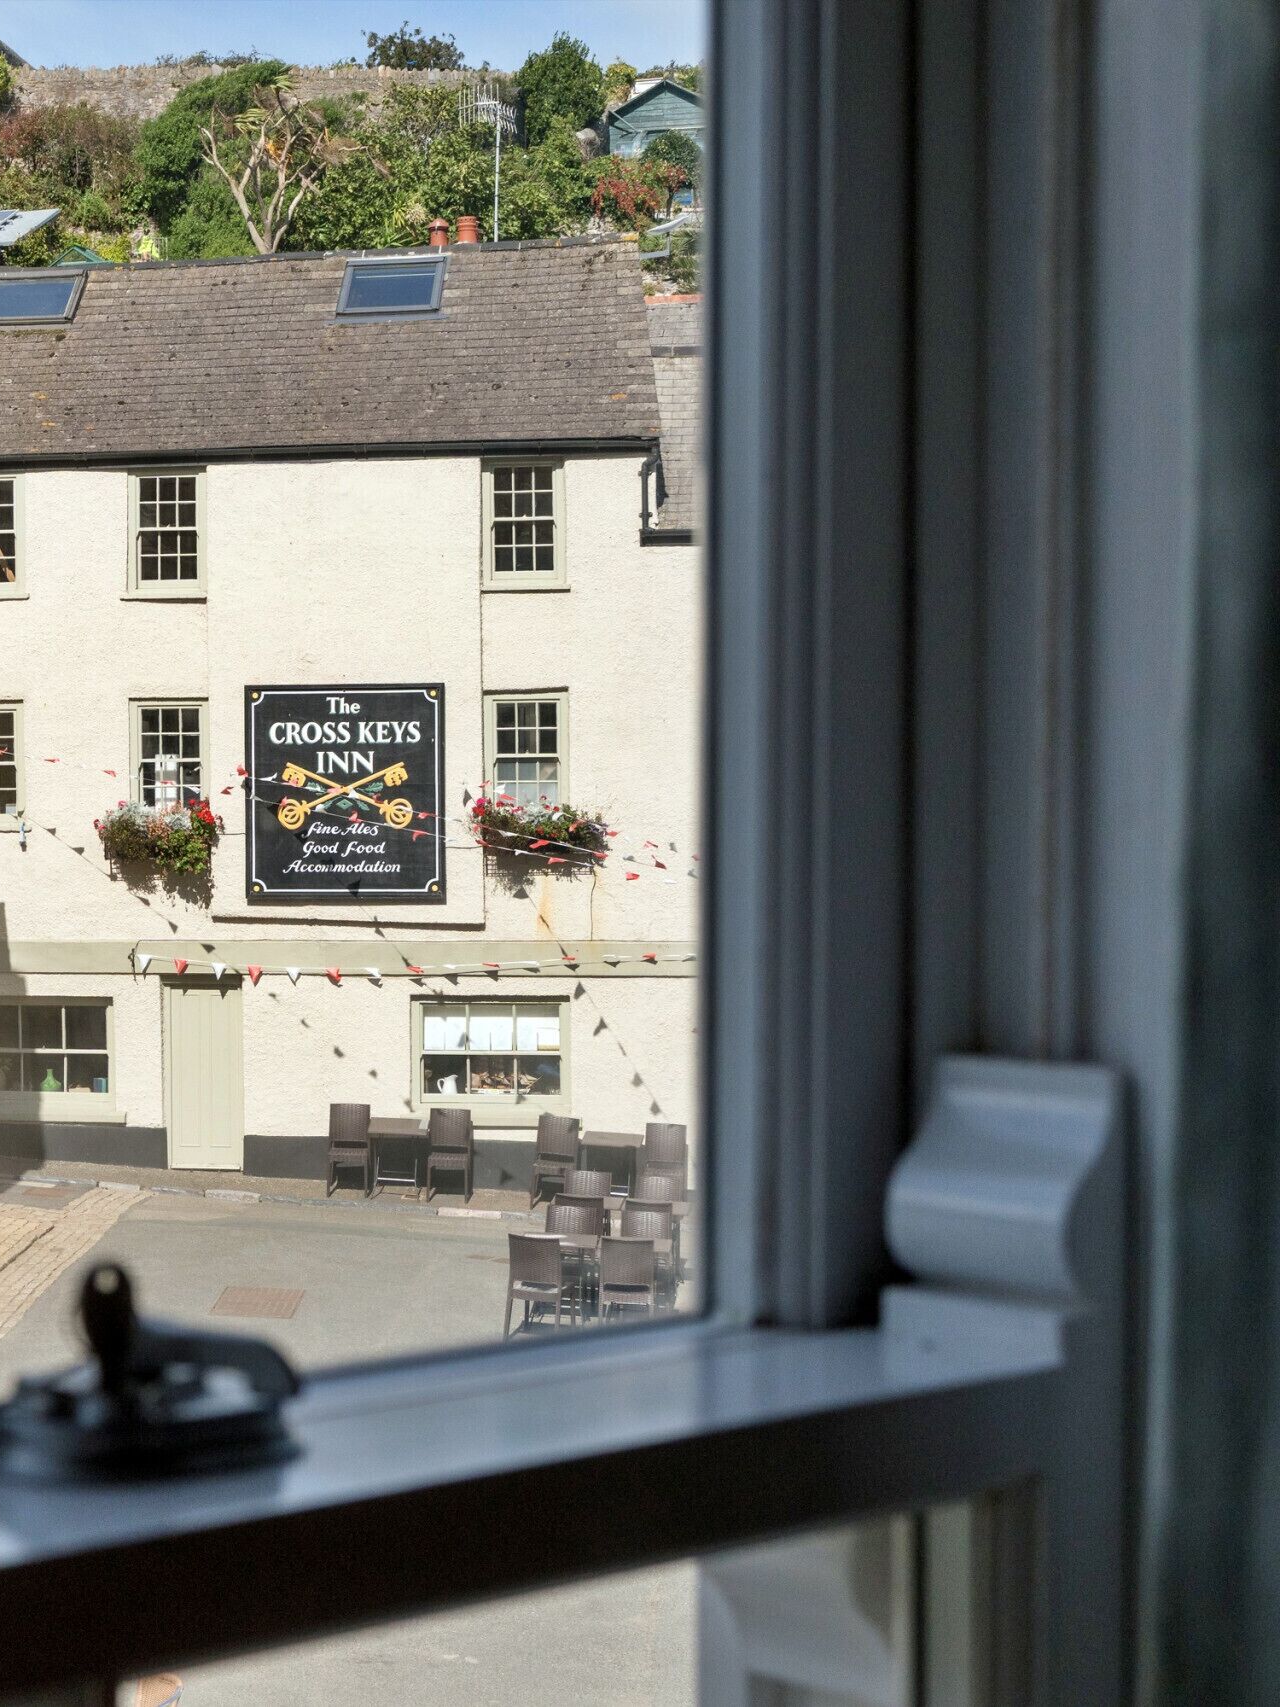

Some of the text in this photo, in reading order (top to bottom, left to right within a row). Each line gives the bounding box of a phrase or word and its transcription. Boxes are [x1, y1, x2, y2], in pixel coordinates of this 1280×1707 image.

[326, 697, 360, 714] The
[269, 721, 421, 745] CROSS KEYS
[316, 751, 375, 774] INN
[302, 822, 378, 838] Fine Ales
[303, 841, 385, 858] Good Food
[283, 859, 401, 873] Accommodation
